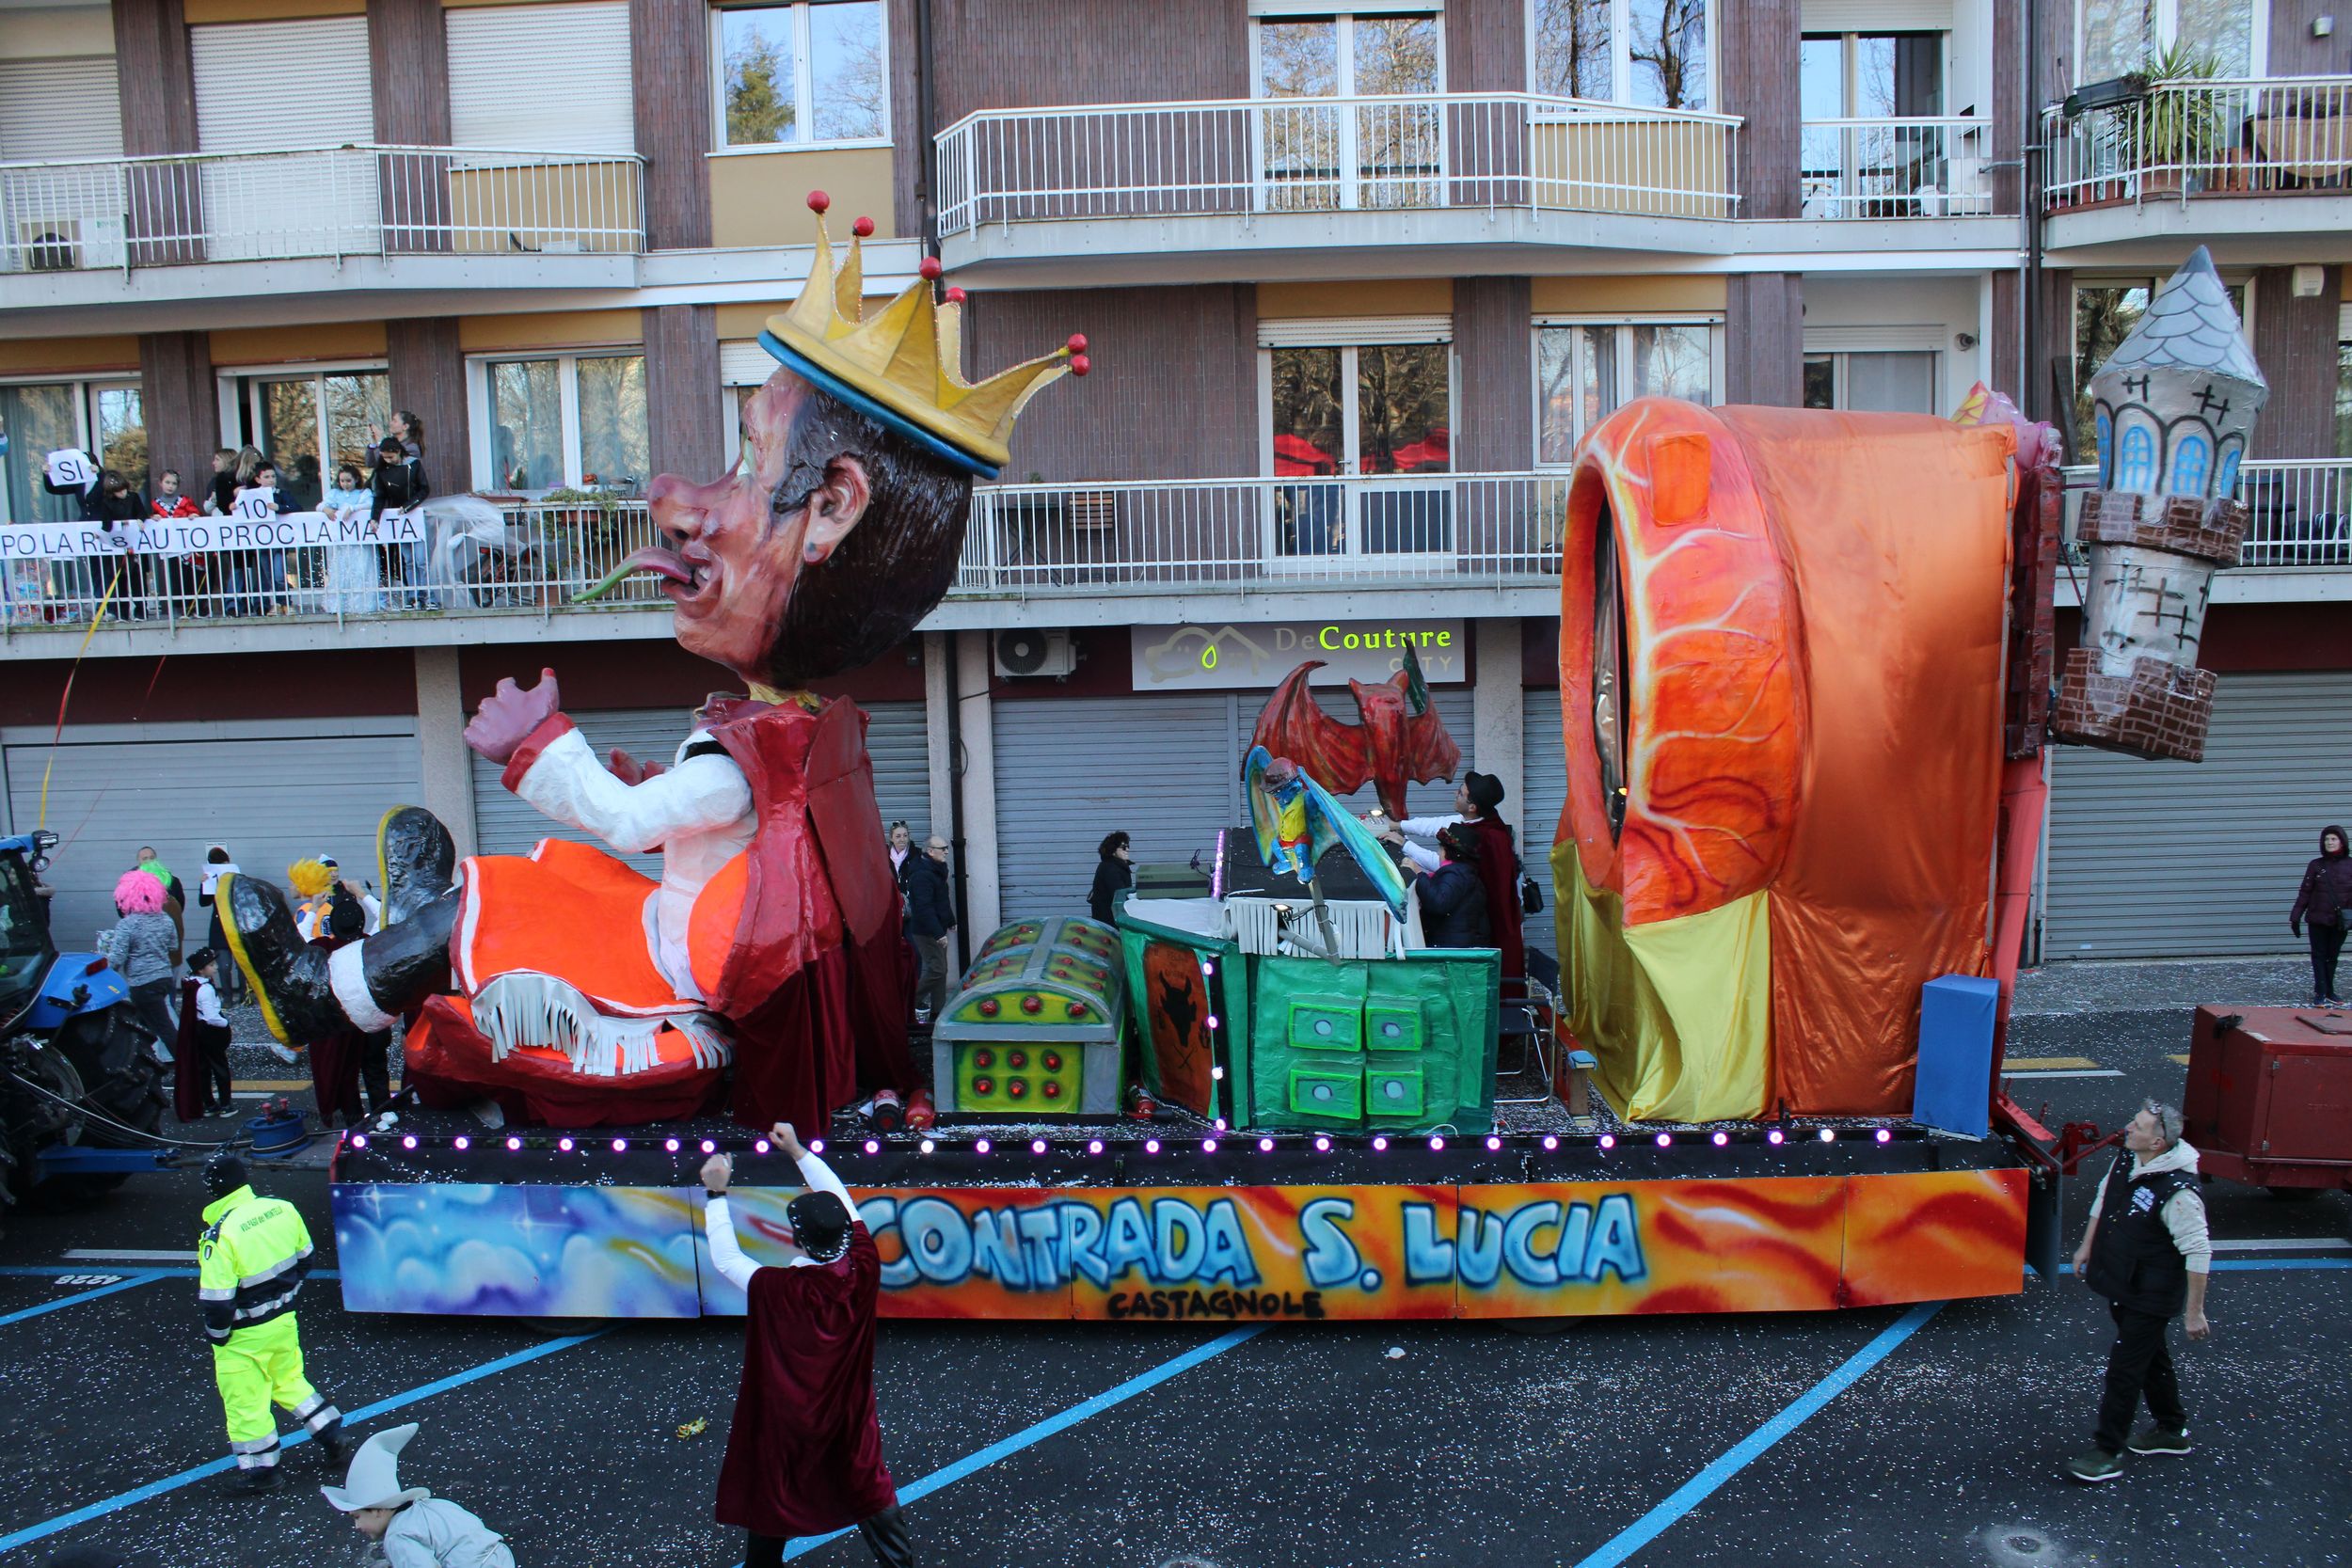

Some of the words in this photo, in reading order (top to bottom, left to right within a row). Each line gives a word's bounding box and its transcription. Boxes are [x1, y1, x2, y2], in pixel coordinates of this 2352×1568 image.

[57, 460, 85, 482] SI
[238, 498, 269, 520] 10
[1389, 656, 1453, 673] CTY
[857, 1196, 1263, 1291] CONTRADA
[1298, 1197, 1382, 1292] S.
[1402, 1192, 1648, 1289] LUCIA
[55, 1275, 122, 1285] 4228
[1107, 1291, 1326, 1320] CASTAGNOLE
